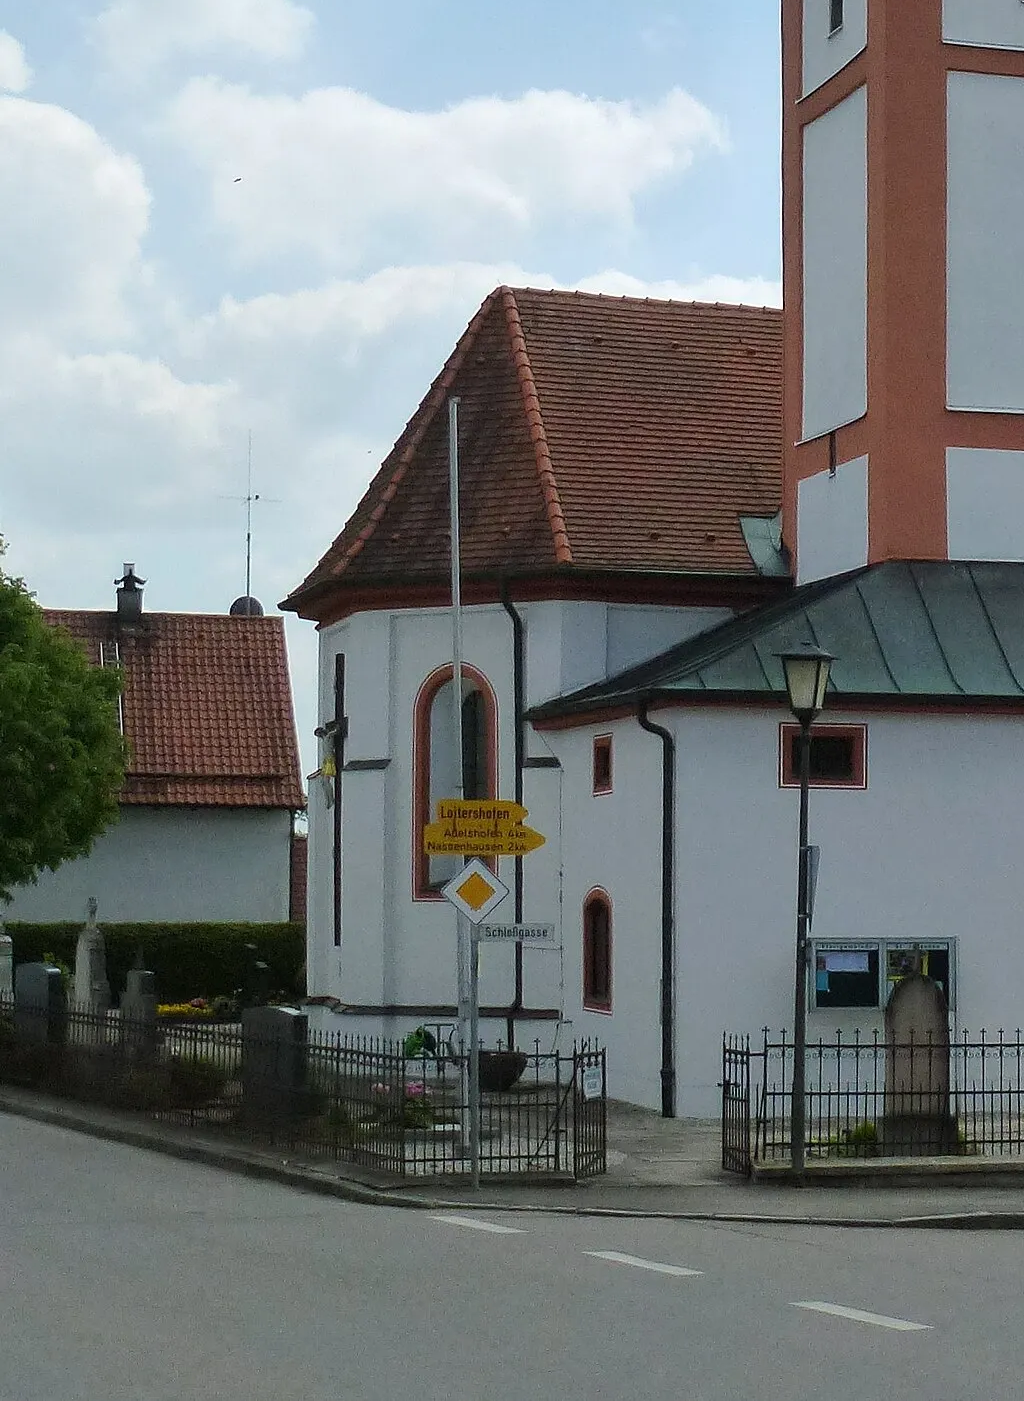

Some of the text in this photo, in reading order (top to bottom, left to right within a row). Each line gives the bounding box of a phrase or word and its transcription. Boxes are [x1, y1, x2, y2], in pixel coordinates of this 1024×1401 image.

[440, 806, 510, 820] Loitershofen
[444, 828, 503, 838] Adelshofen
[427, 841, 503, 851] Nassenhausen
[485, 926, 548, 939] Schloßgasse
